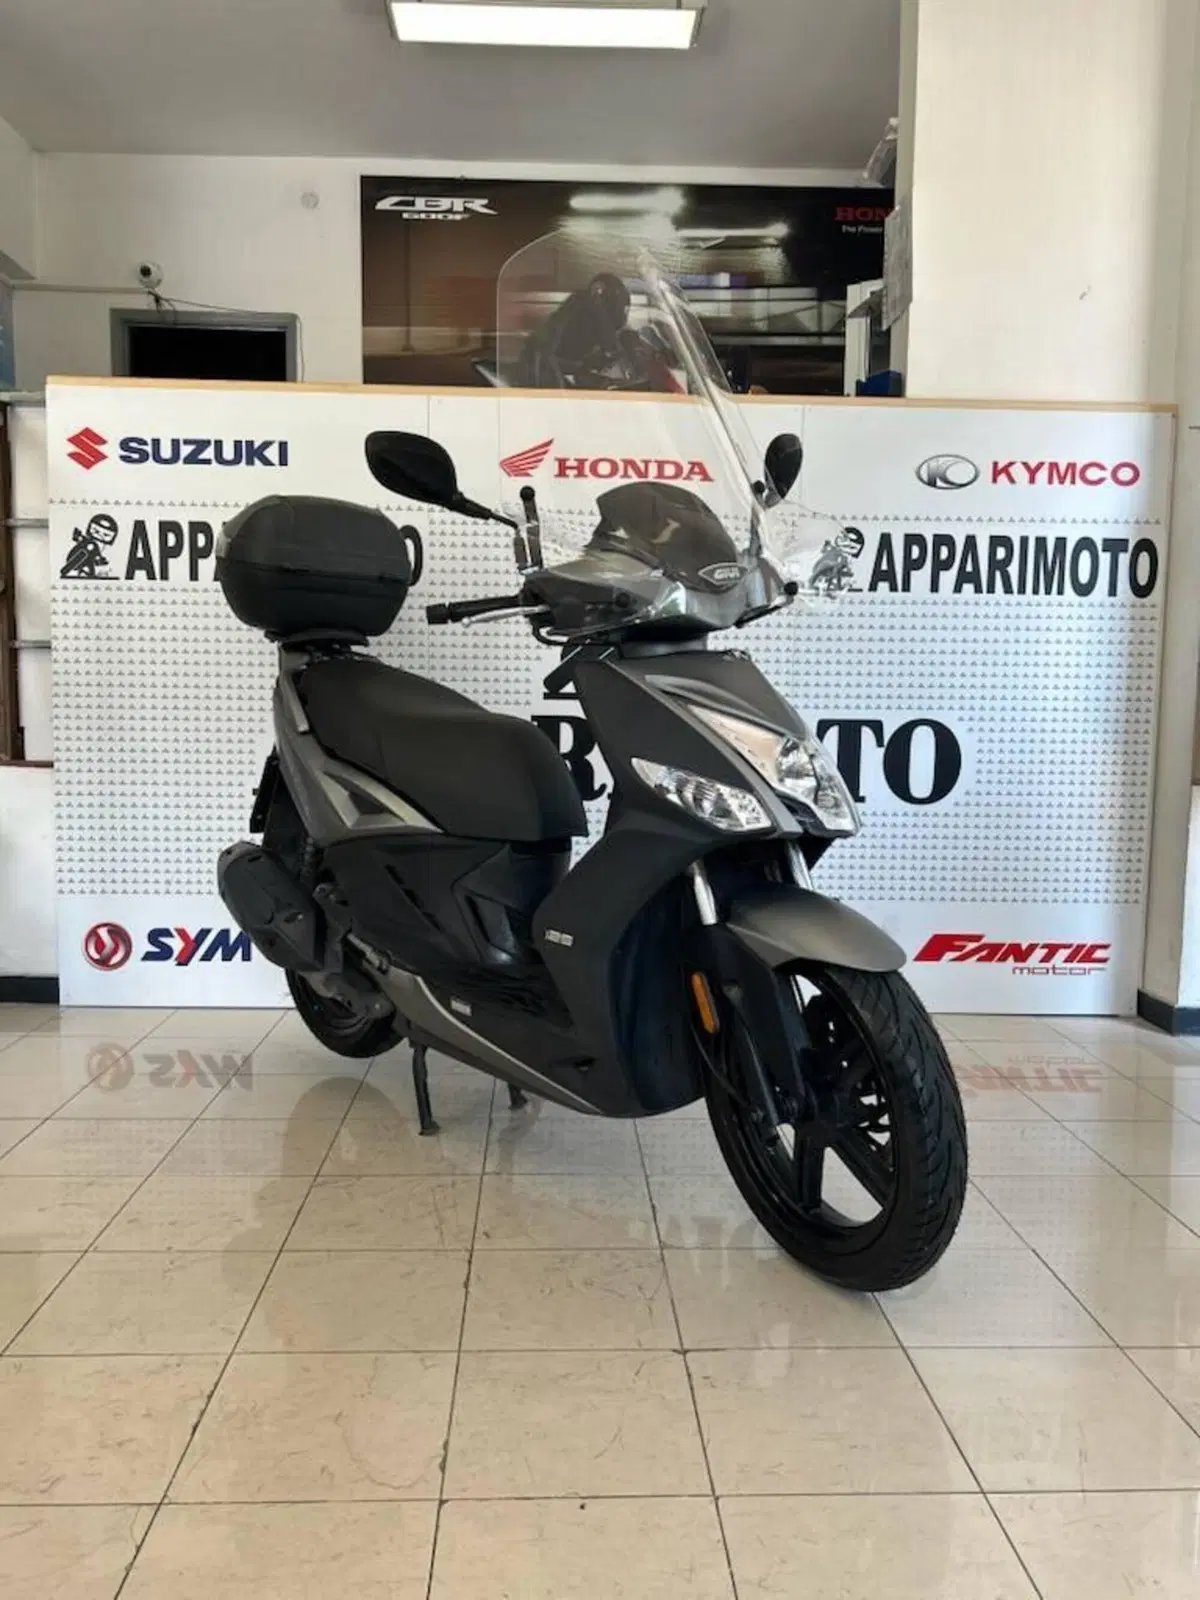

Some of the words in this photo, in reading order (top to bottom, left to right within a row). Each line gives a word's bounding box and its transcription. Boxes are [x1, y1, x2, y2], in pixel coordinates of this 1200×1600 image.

[375, 196, 499, 215] CBR
[835, 207, 889, 220] HON
[118, 437, 289, 466] SUZUKI
[554, 457, 714, 481] HONDA
[991, 461, 1141, 486] KYMCO
[125, 520, 220, 581] APP
[867, 532, 1159, 598] APPARIMOTO
[141, 928, 252, 966] SYM
[913, 933, 1111, 963] FANTIC
[1012, 964, 1107, 975] motor
